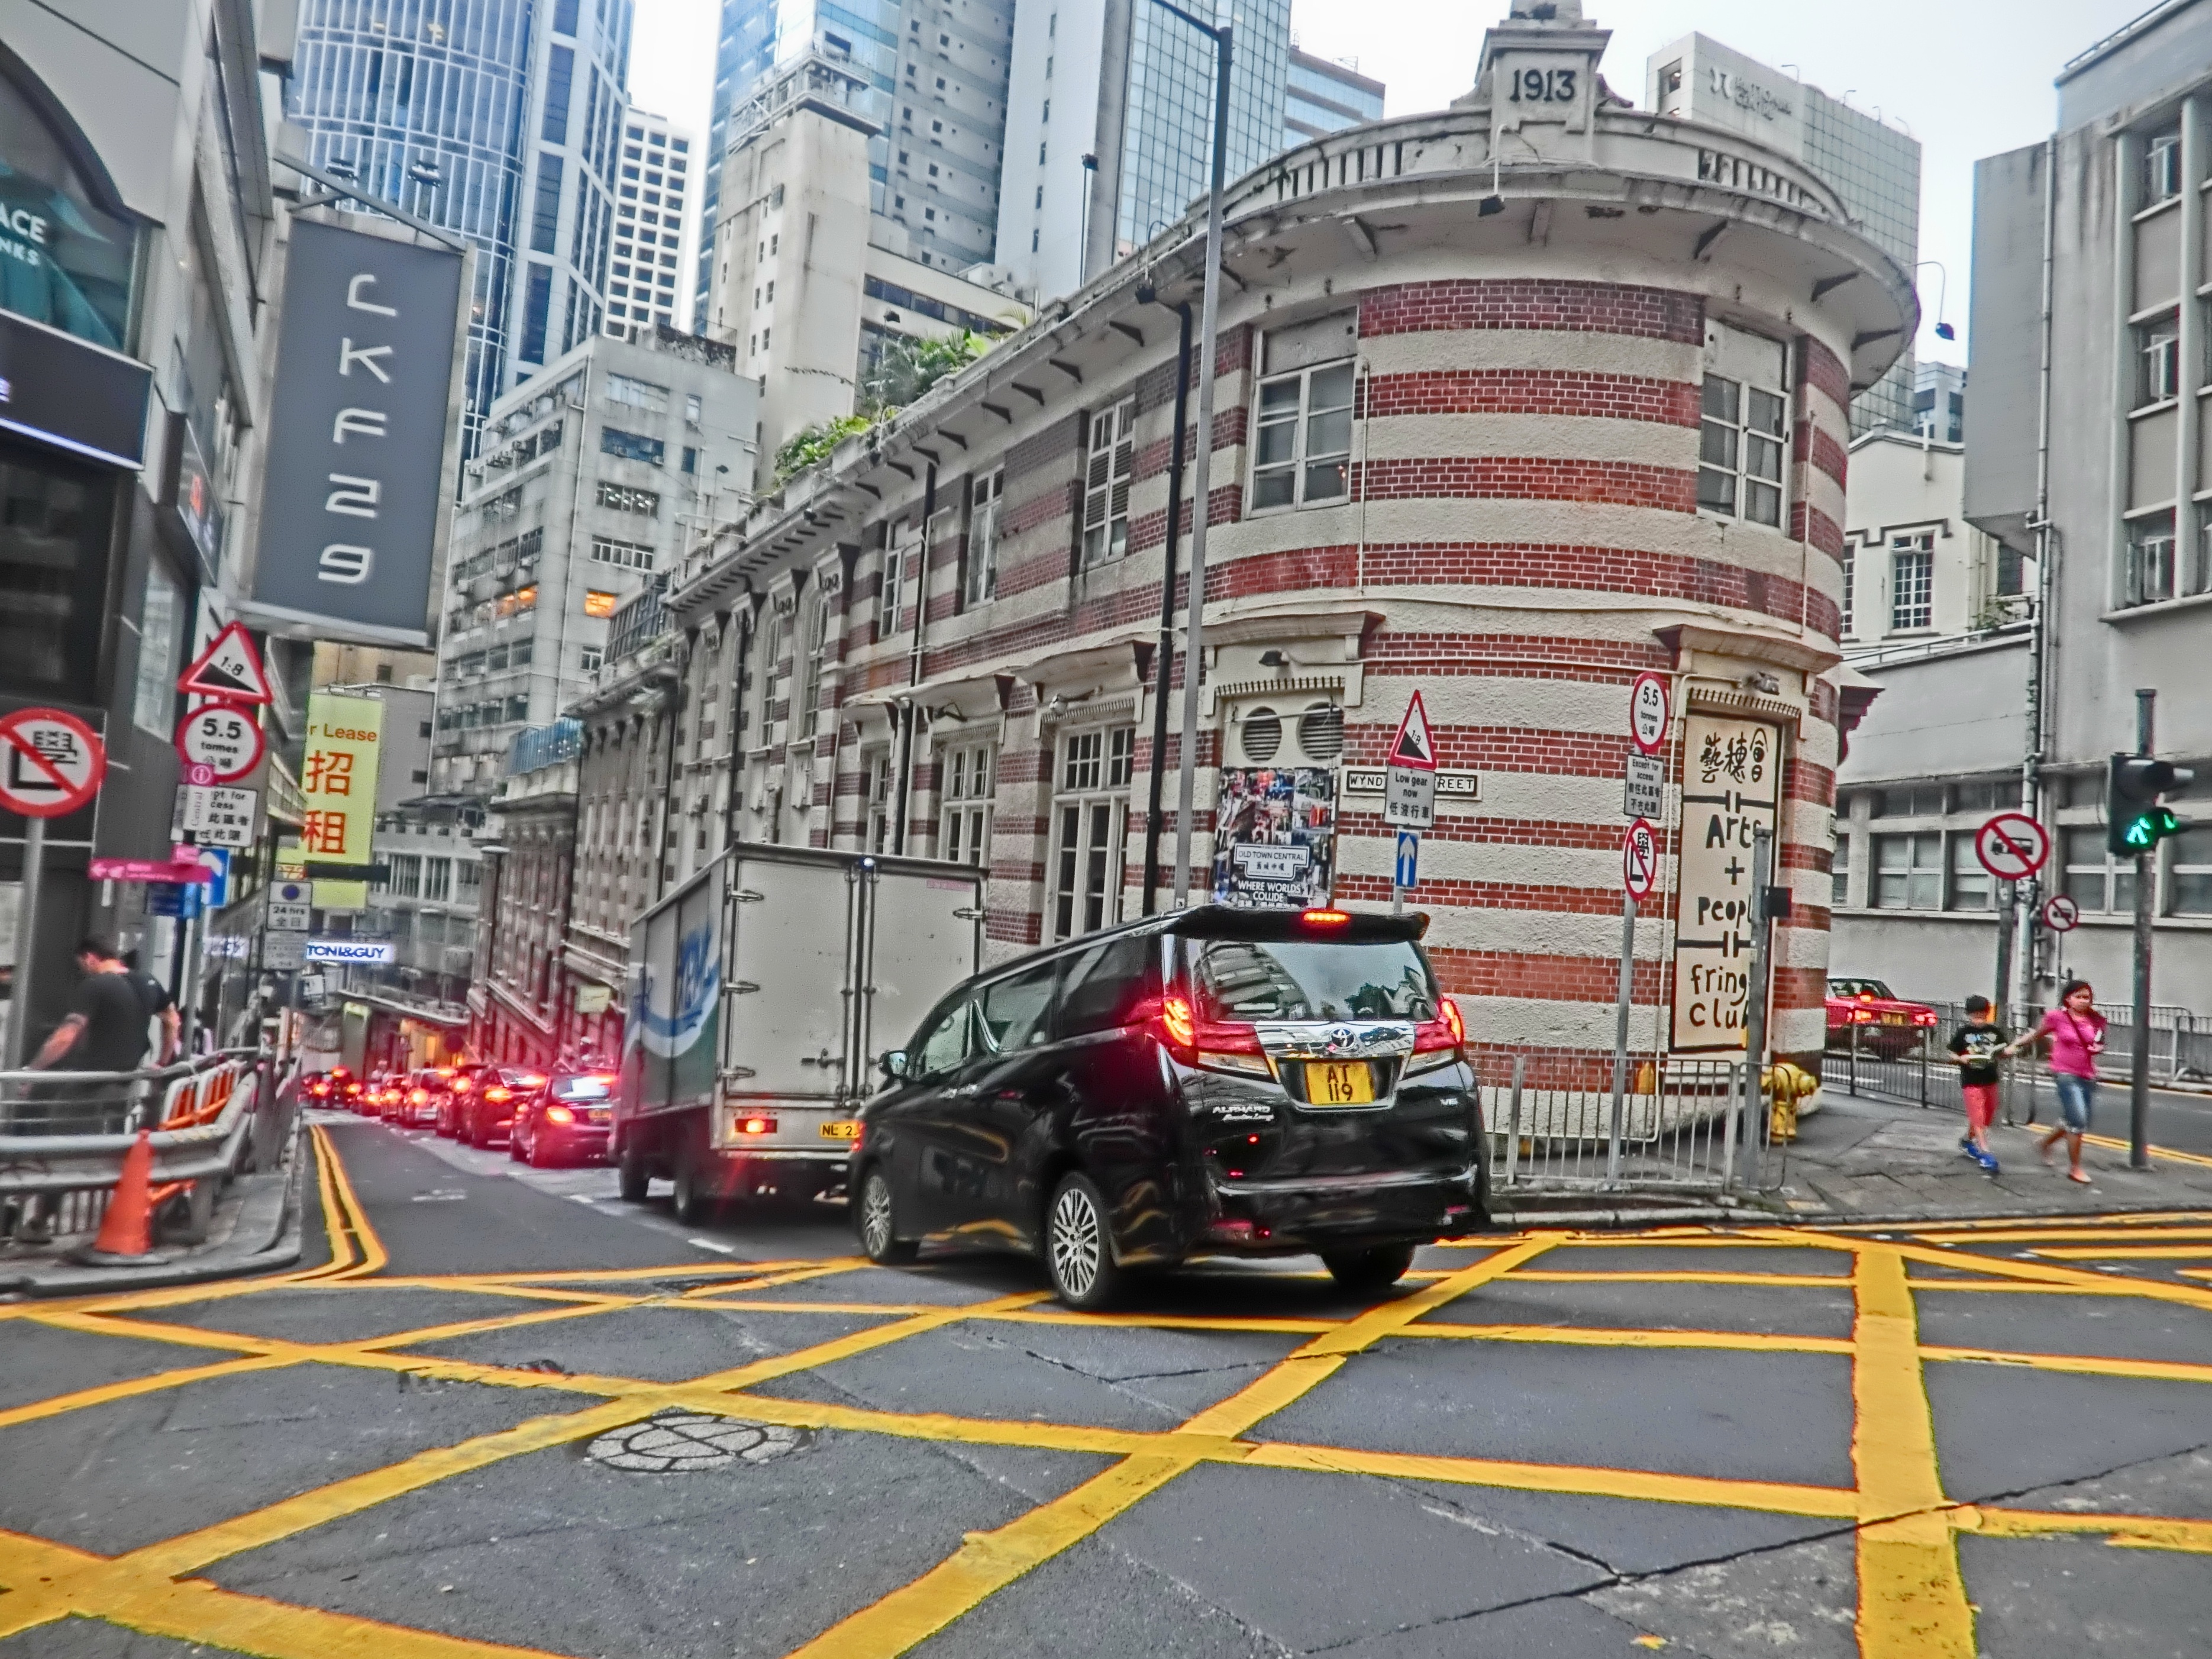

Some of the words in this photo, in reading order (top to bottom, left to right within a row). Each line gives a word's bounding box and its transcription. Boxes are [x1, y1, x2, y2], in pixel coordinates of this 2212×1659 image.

[1510, 69, 1576, 102] 1913
[221, 656, 244, 676] 1:8
[1643, 686, 1658, 706] 5.5
[1641, 711, 1658, 722] tonnes
[202, 718, 241, 740] 5.5
[324, 724, 377, 742] Lease
[1411, 730, 1421, 745] 1:8
[201, 741, 238, 754] tonnes
[1350, 775, 1383, 787] WYND
[1438, 778, 1473, 789] REET
[1395, 772, 1409, 783] Low
[1412, 776, 1428, 787] gear
[1403, 789, 1418, 798] now
[301, 750, 354, 854] 招租
[1390, 801, 1430, 819] 低波行車
[1252, 851, 1273, 860] TOWN
[1274, 853, 1304, 861] CENTRAL
[1238, 880, 1265, 891] WHERE
[1267, 882, 1301, 893] WORLDS
[1252, 891, 1284, 902] COLLIDE
[273, 906, 286, 914] 24
[307, 944, 385, 958] TONI&GUY
[1690, 964, 1748, 1006] fring
[1328, 1064, 1350, 1083] AT
[1328, 1083, 1354, 1102] 119
[822, 1125, 838, 1136] NL
[845, 1125, 857, 1136] 2
